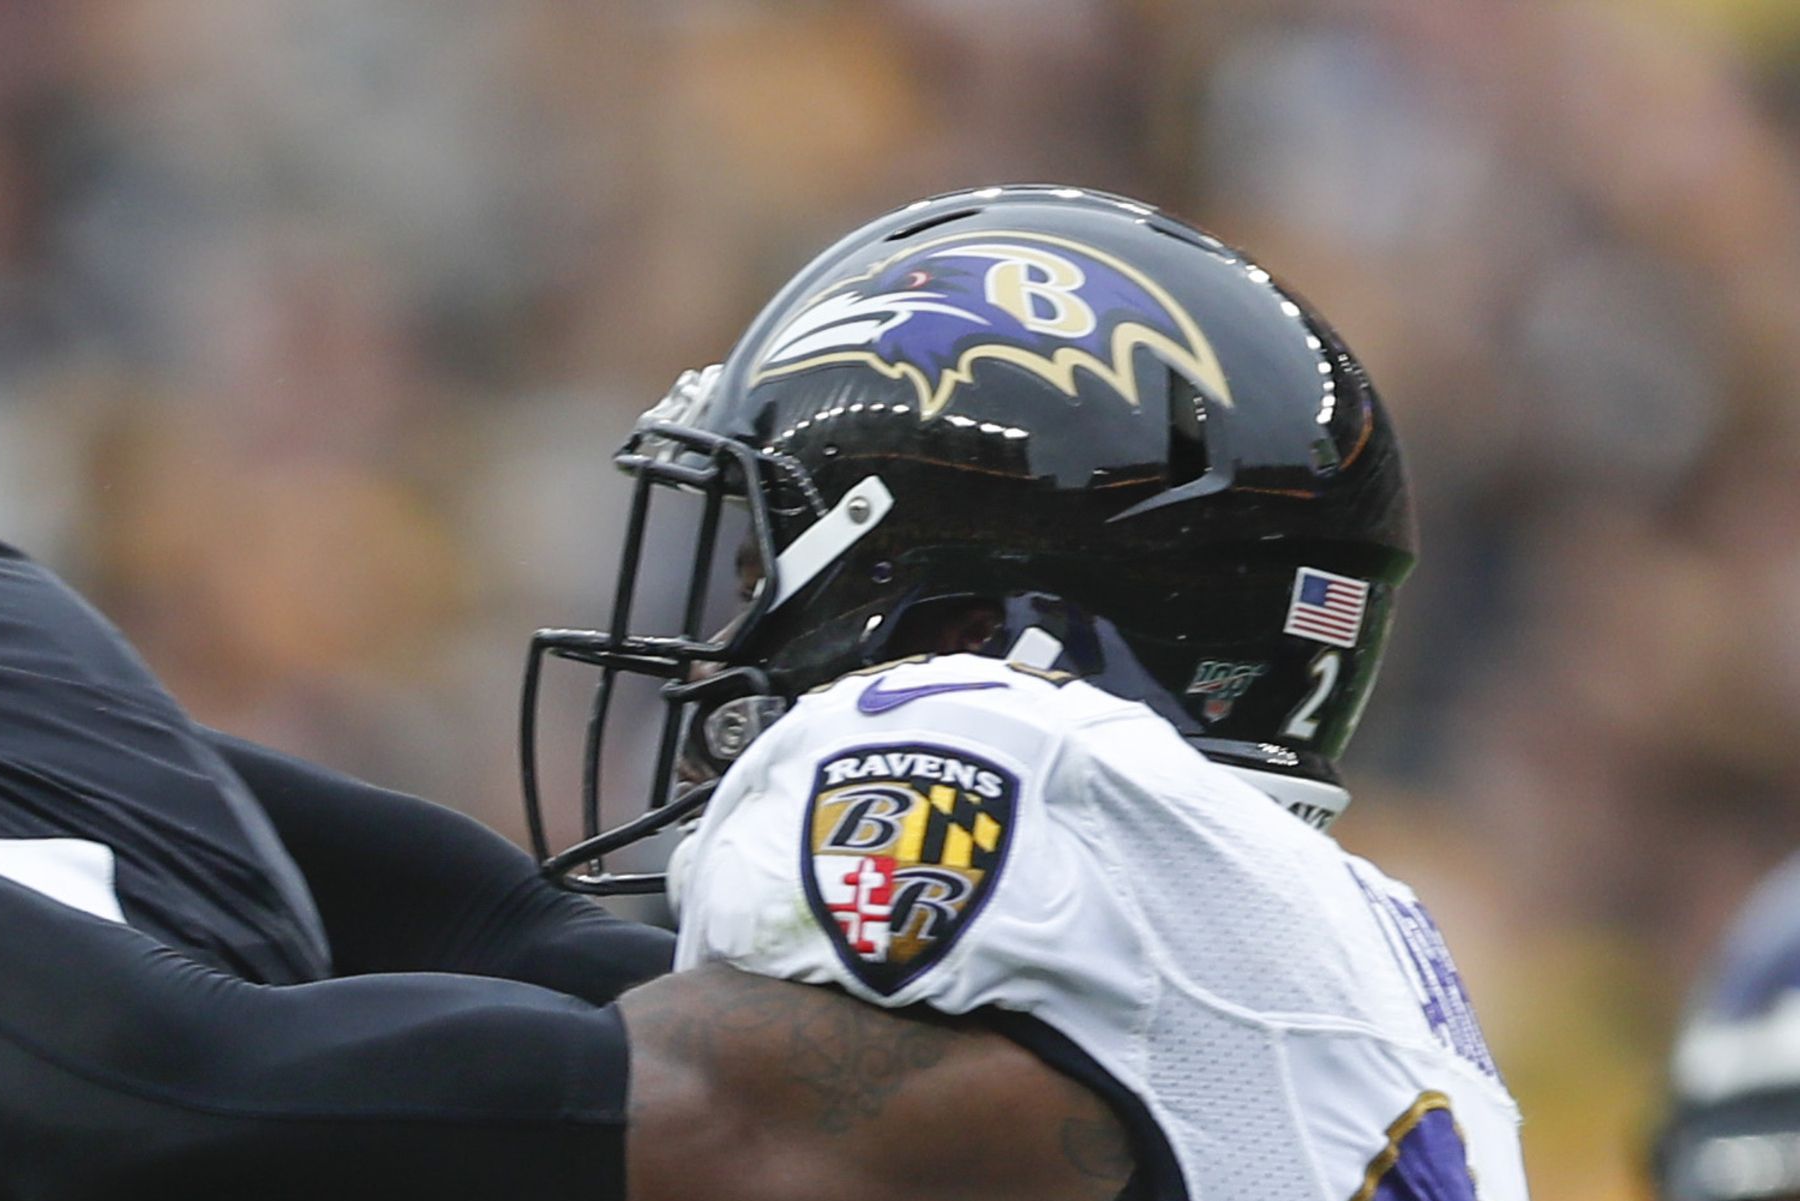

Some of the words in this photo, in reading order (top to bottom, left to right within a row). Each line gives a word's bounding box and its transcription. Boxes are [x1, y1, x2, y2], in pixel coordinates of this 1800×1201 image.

[983, 244, 1098, 339] B
[1285, 651, 1342, 741] 2
[822, 752, 1005, 799] RAVENS
[819, 783, 921, 852] B
[889, 867, 974, 941] R
